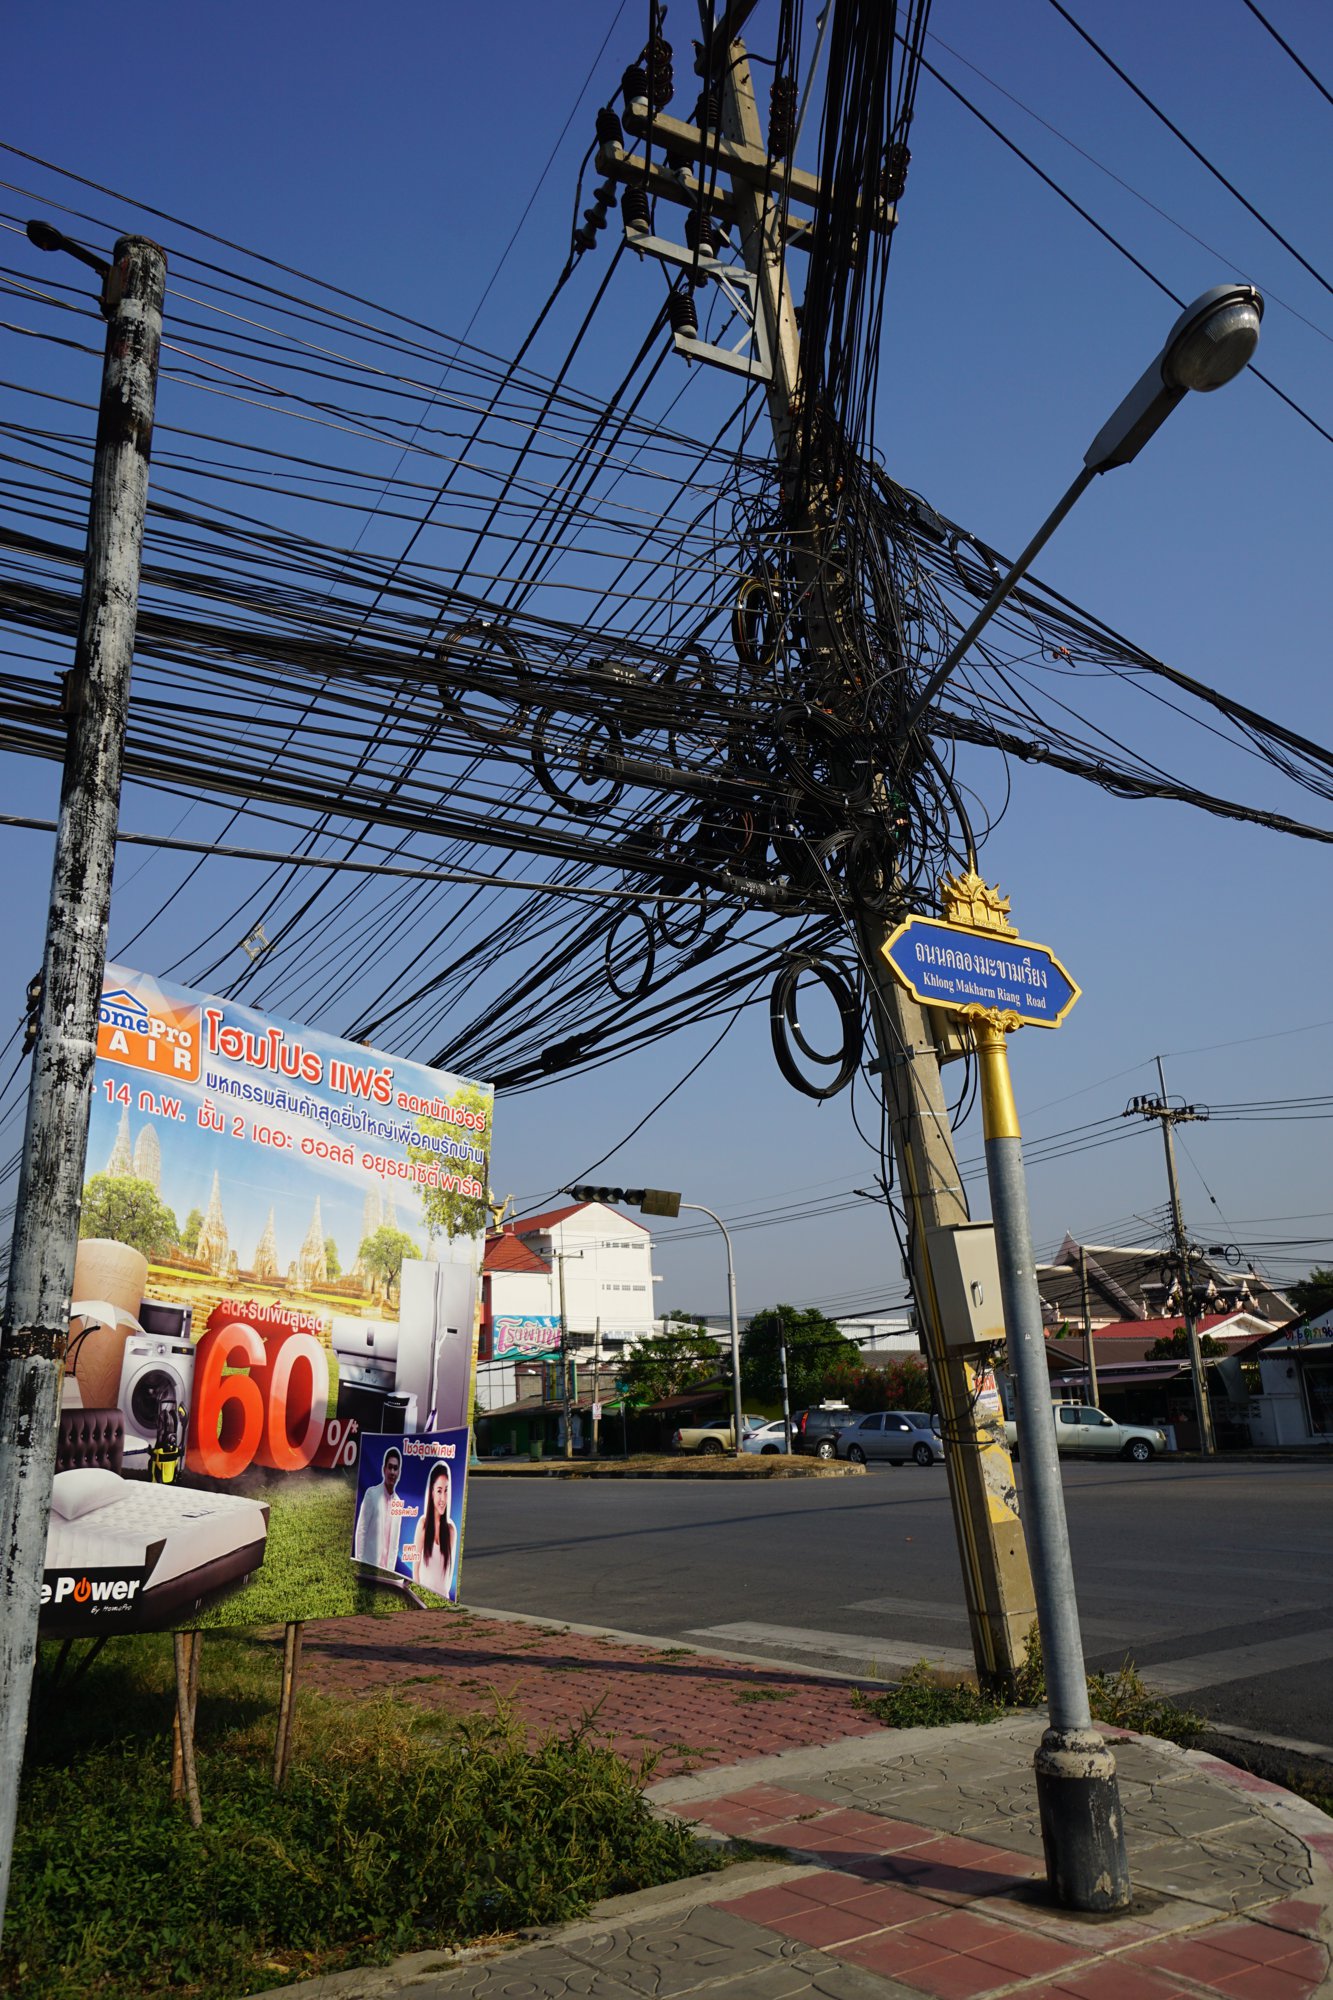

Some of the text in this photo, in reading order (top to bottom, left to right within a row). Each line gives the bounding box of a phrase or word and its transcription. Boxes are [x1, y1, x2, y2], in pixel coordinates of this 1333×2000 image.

[915, 942, 1047, 988] ถนนคลองมะขามเรียง
[923, 972, 1046, 1009] Khlong Makharm Riang Road
[98, 1007, 192, 1048] omePro
[109, 1030, 192, 1072] AIR
[205, 1008, 323, 1084] โฮมโปร
[330, 1060, 393, 1103] แฟร์
[104, 1079, 131, 1106] 14
[139, 1091, 186, 1122] ก.พ.
[198, 1099, 225, 1132] ชั้น
[232, 1116, 245, 1137] 2
[253, 1124, 293, 1149] เดอะ
[301, 1138, 355, 1165] ฮอลล์
[54, 1577, 140, 1603] Power
